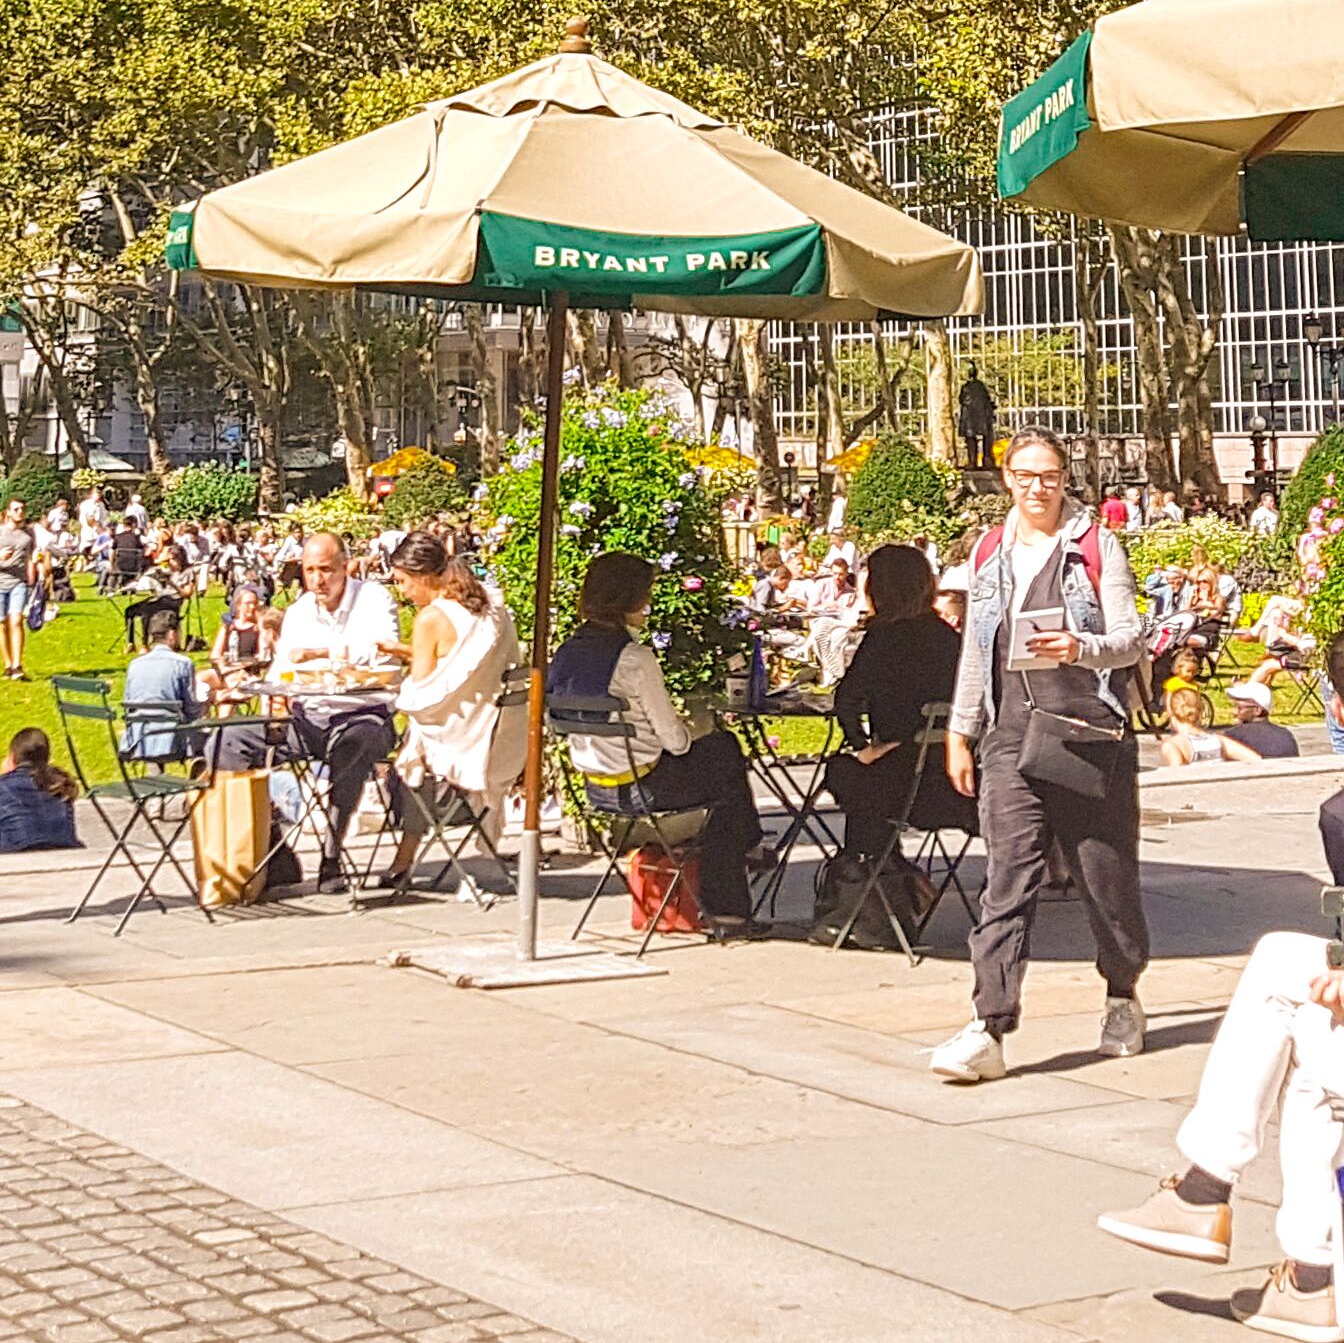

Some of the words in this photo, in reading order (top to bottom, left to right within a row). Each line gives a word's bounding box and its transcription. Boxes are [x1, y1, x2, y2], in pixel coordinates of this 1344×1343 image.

[1009, 104, 1042, 154] BRYANT
[1045, 78, 1074, 124] PARK
[534, 246, 668, 273] BRYANT
[686, 251, 770, 271] PARK
